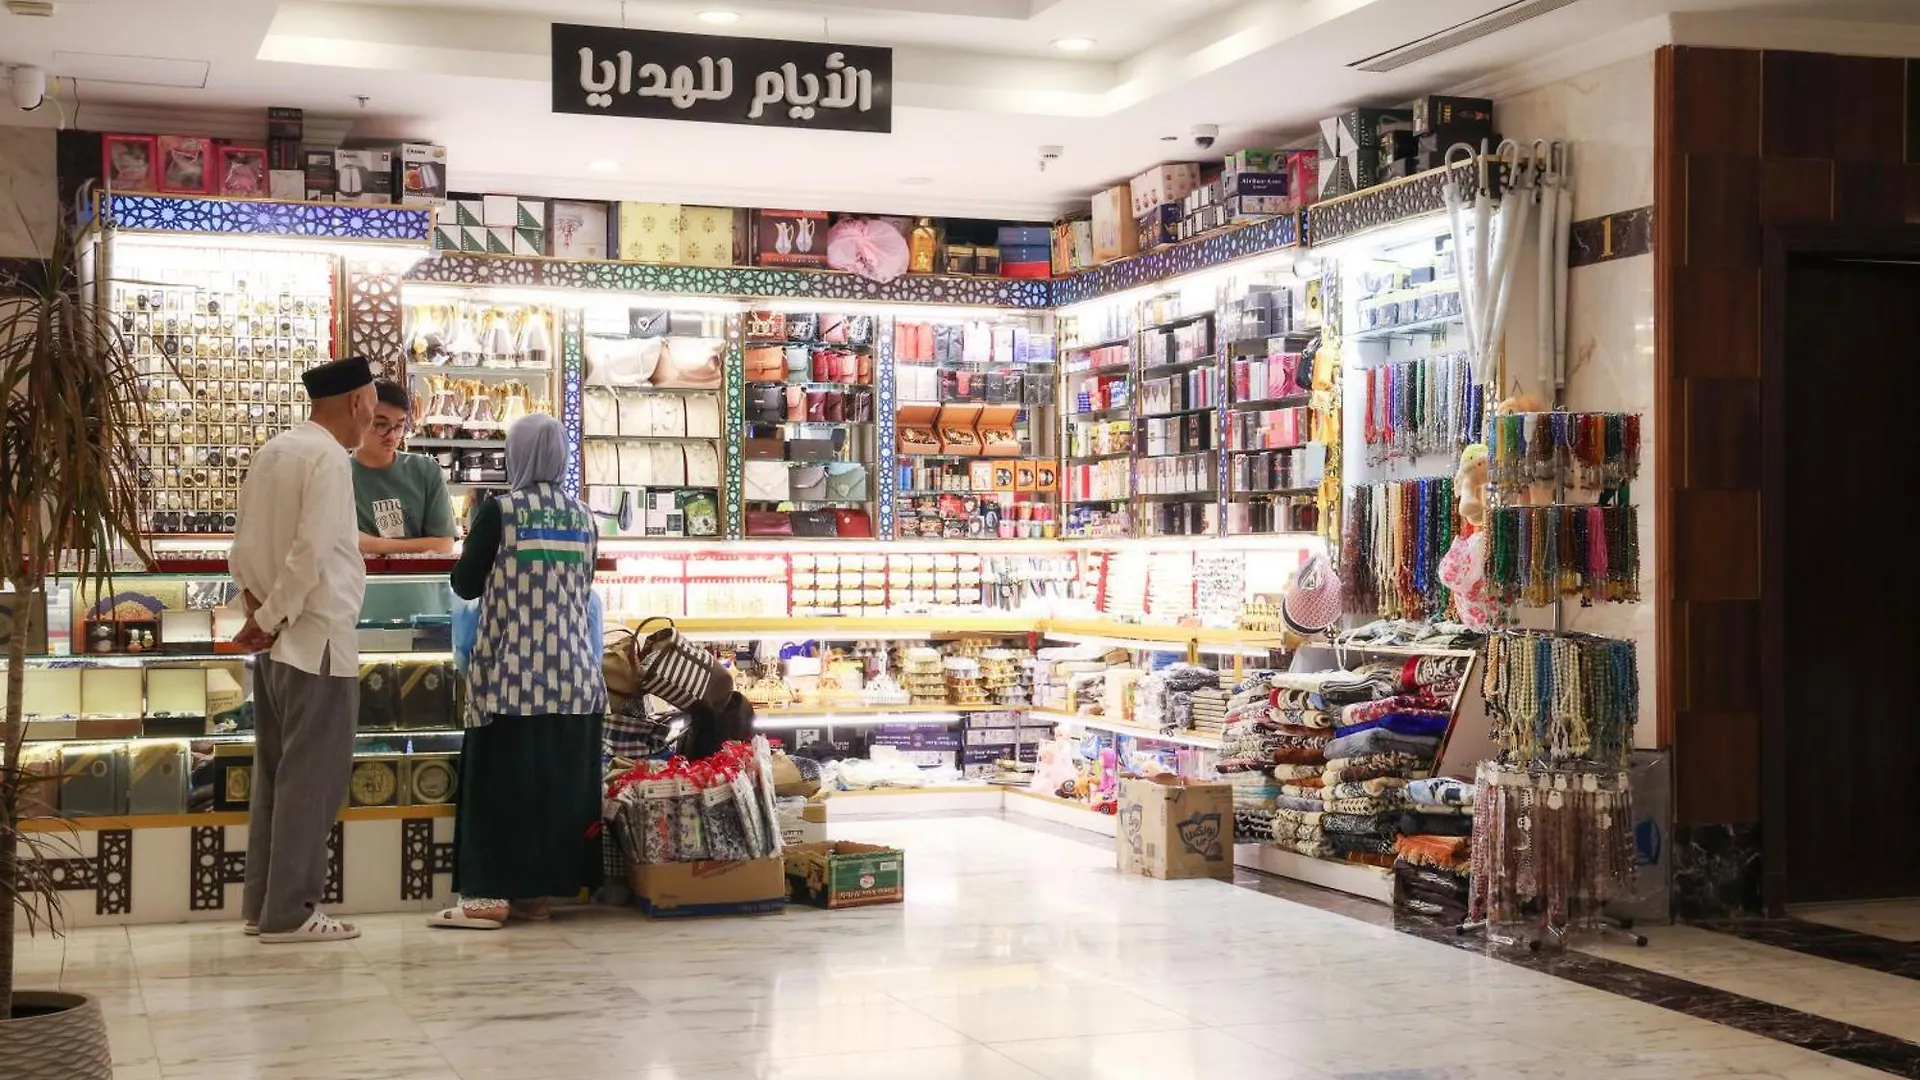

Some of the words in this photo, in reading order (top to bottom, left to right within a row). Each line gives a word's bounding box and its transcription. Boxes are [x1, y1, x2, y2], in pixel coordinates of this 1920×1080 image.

[578, 47, 733, 109] للهدايا
[747, 51, 873, 120] الأيام
[1601, 216, 1614, 257] 1
